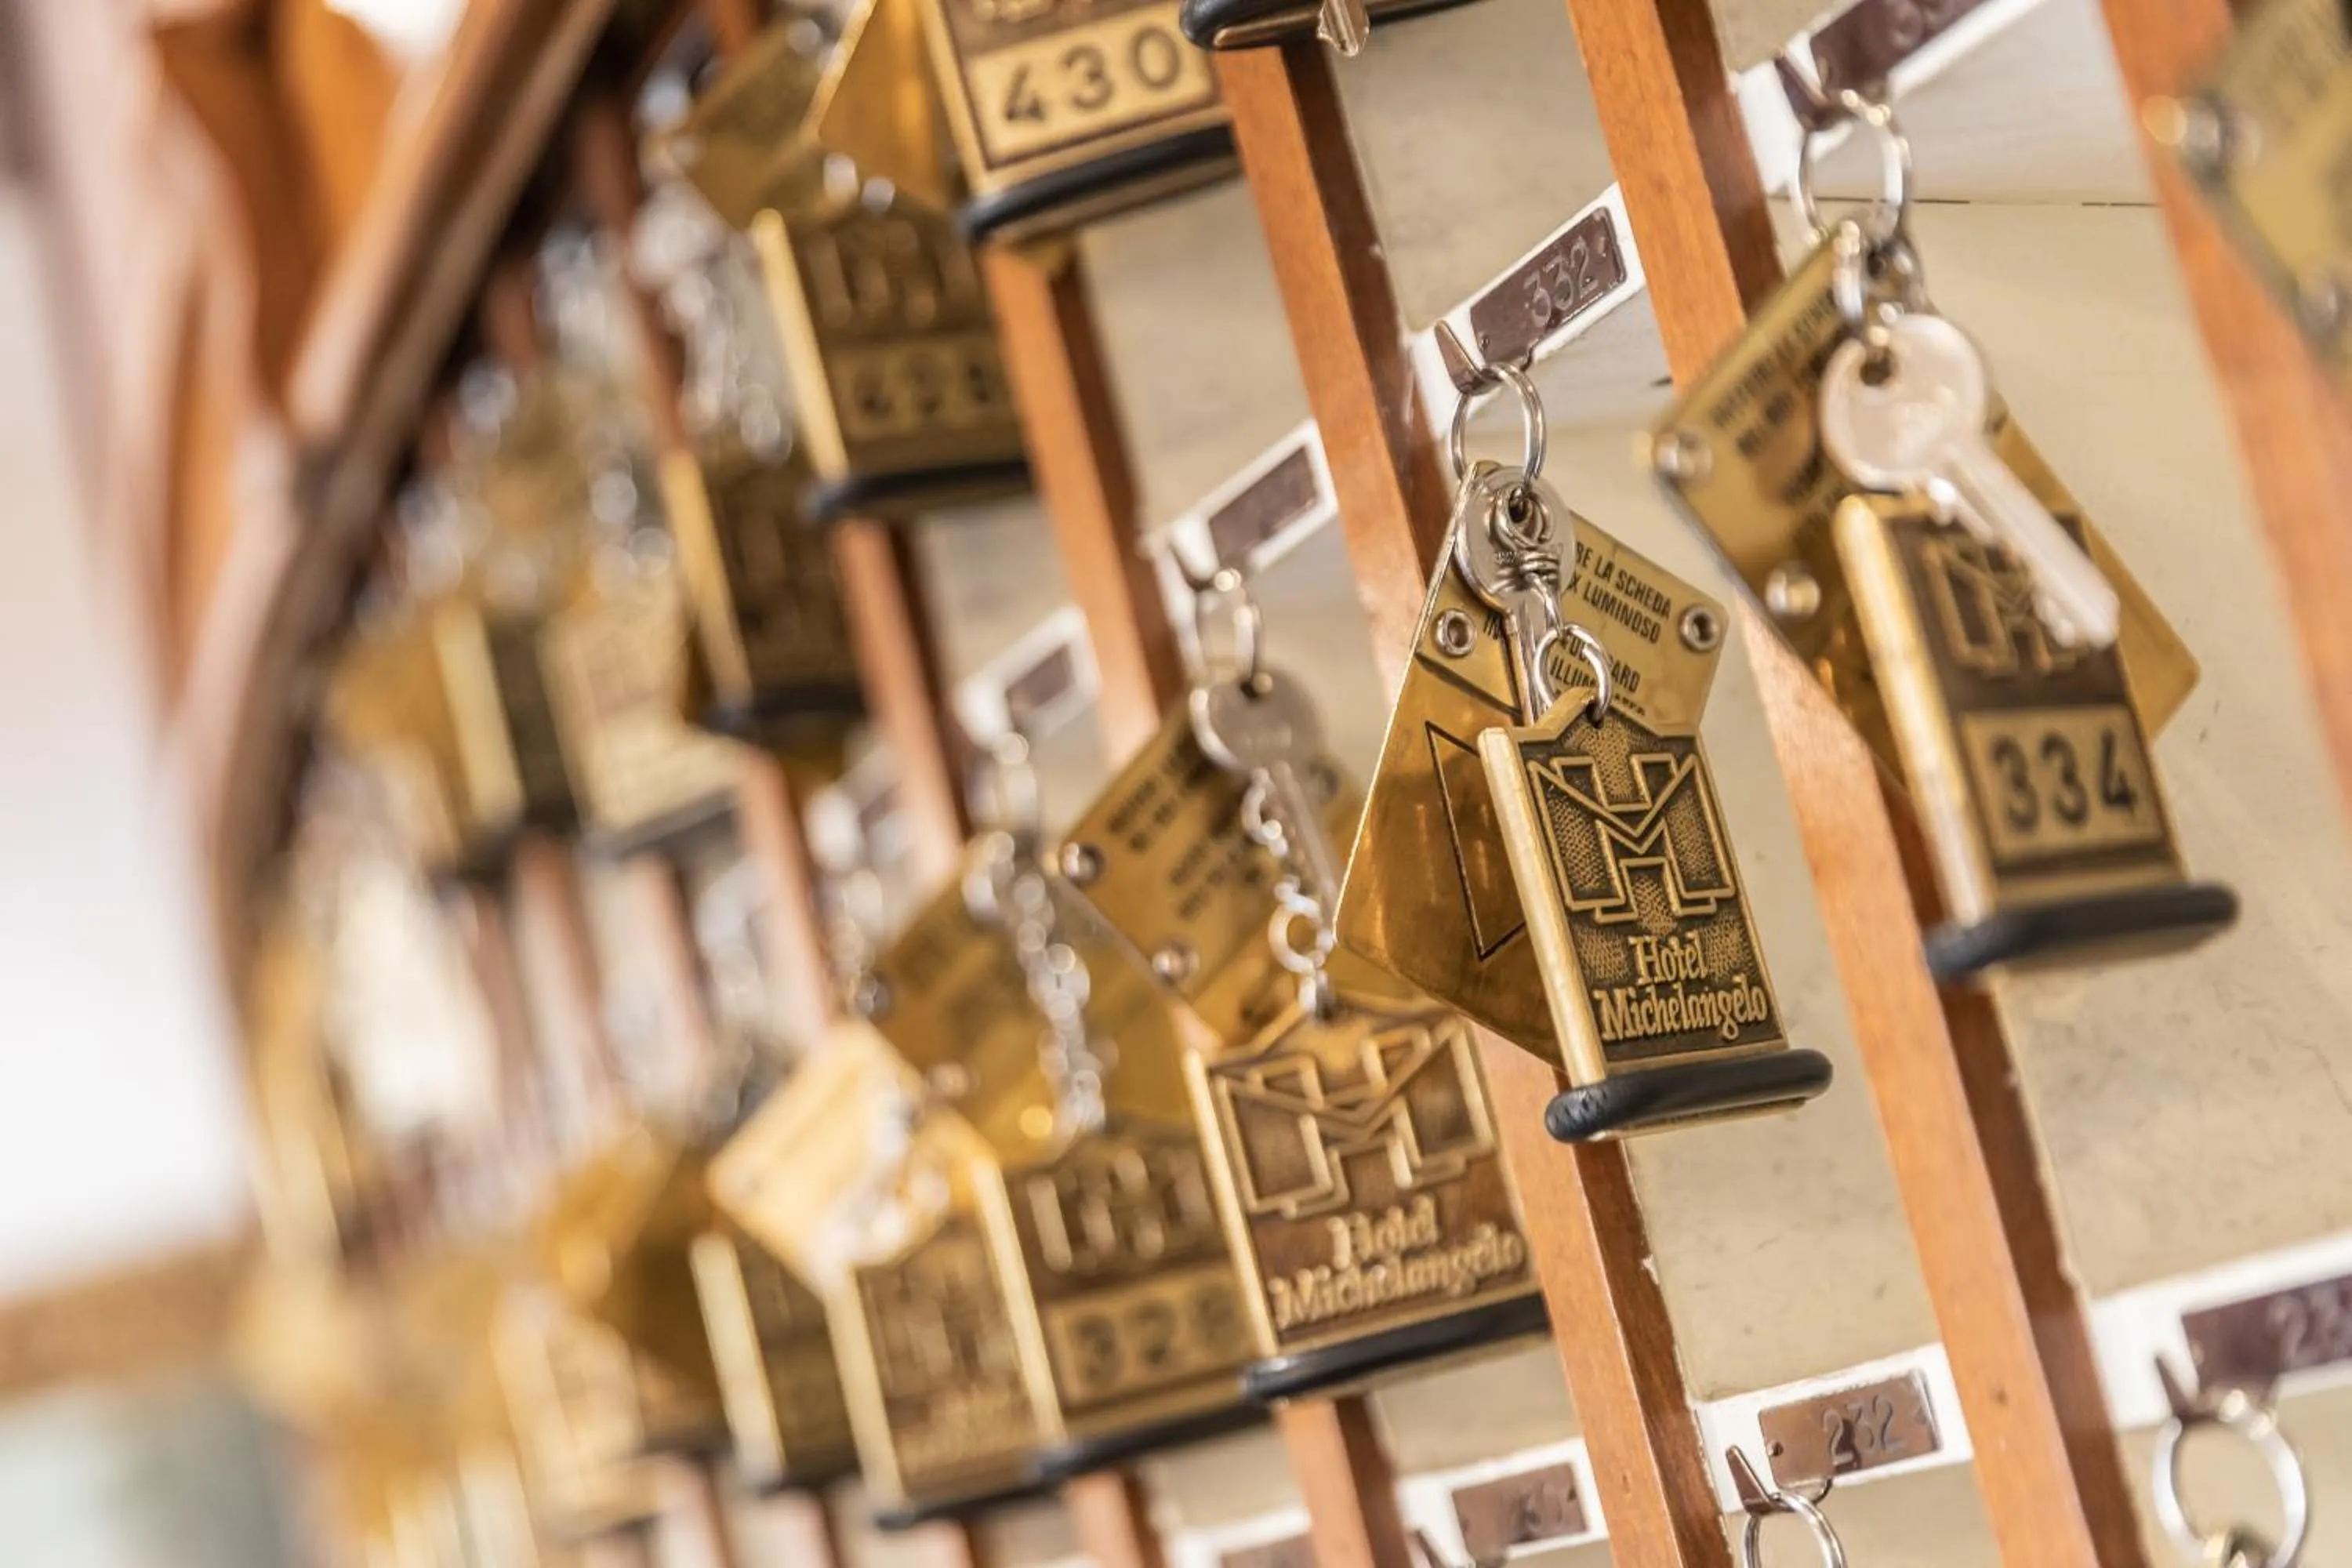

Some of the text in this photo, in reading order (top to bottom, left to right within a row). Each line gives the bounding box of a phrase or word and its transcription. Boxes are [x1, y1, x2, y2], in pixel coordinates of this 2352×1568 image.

[1004, 27, 1178, 124] 430
[1523, 235, 1599, 328] 332
[1583, 581, 1661, 644] LUMINOSO
[1595, 554, 1615, 583] LA
[1615, 569, 1671, 621] SCHEDA
[1610, 655, 1641, 693] ARD
[1990, 727, 2139, 835] 334
[1628, 931, 1709, 985] Hotel
[1593, 974, 1769, 1041] Michelangelo
[1326, 1194, 1439, 1271] Hotel
[1269, 1223, 1525, 1330] Michelangelo
[1821, 1394, 1907, 1466] 232
